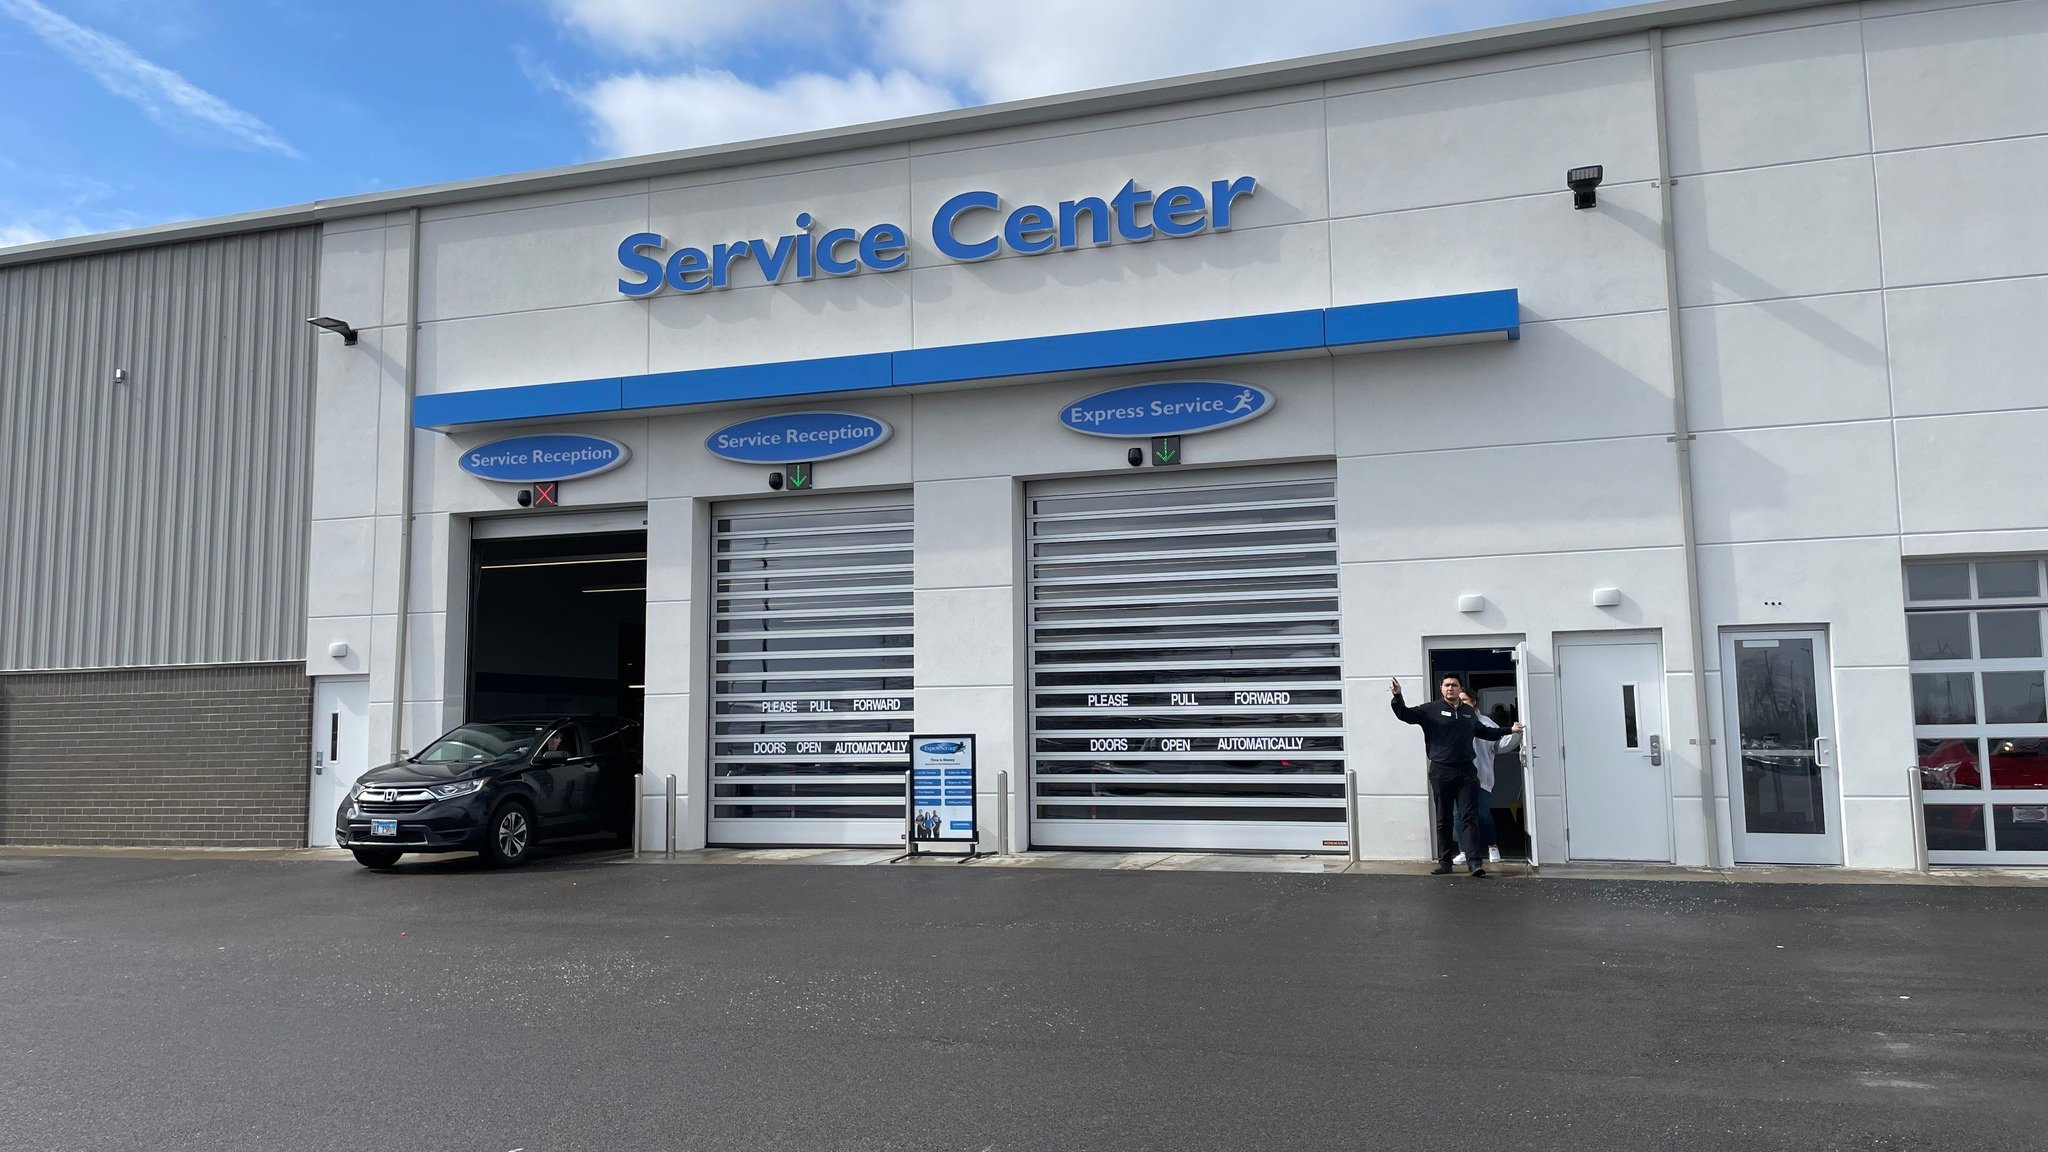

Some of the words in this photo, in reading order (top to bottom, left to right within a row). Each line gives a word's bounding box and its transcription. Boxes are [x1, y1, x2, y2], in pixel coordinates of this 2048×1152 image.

[617, 213, 908, 299] Service
[932, 175, 1257, 262] Center
[1070, 405, 1144, 426] Express
[1150, 398, 1224, 416] Service
[717, 431, 781, 450] Service
[786, 423, 875, 444] Reception
[470, 453, 528, 468] Service
[532, 447, 613, 467] Reception
[762, 701, 798, 713] PLEASE
[809, 700, 834, 712] PULL
[853, 698, 901, 711] FORWARD
[1088, 694, 1129, 707] PLEASE
[1171, 693, 1199, 706] PULL
[1234, 691, 1290, 705] FORWARD
[753, 741, 787, 754] DOORS
[796, 741, 822, 753] OPEN
[834, 741, 908, 754] AUTOMATICALLY
[1090, 738, 1128, 751] DOORS
[1161, 738, 1191, 752] OPEN
[1217, 737, 1304, 750] AUTOMATICALLY
